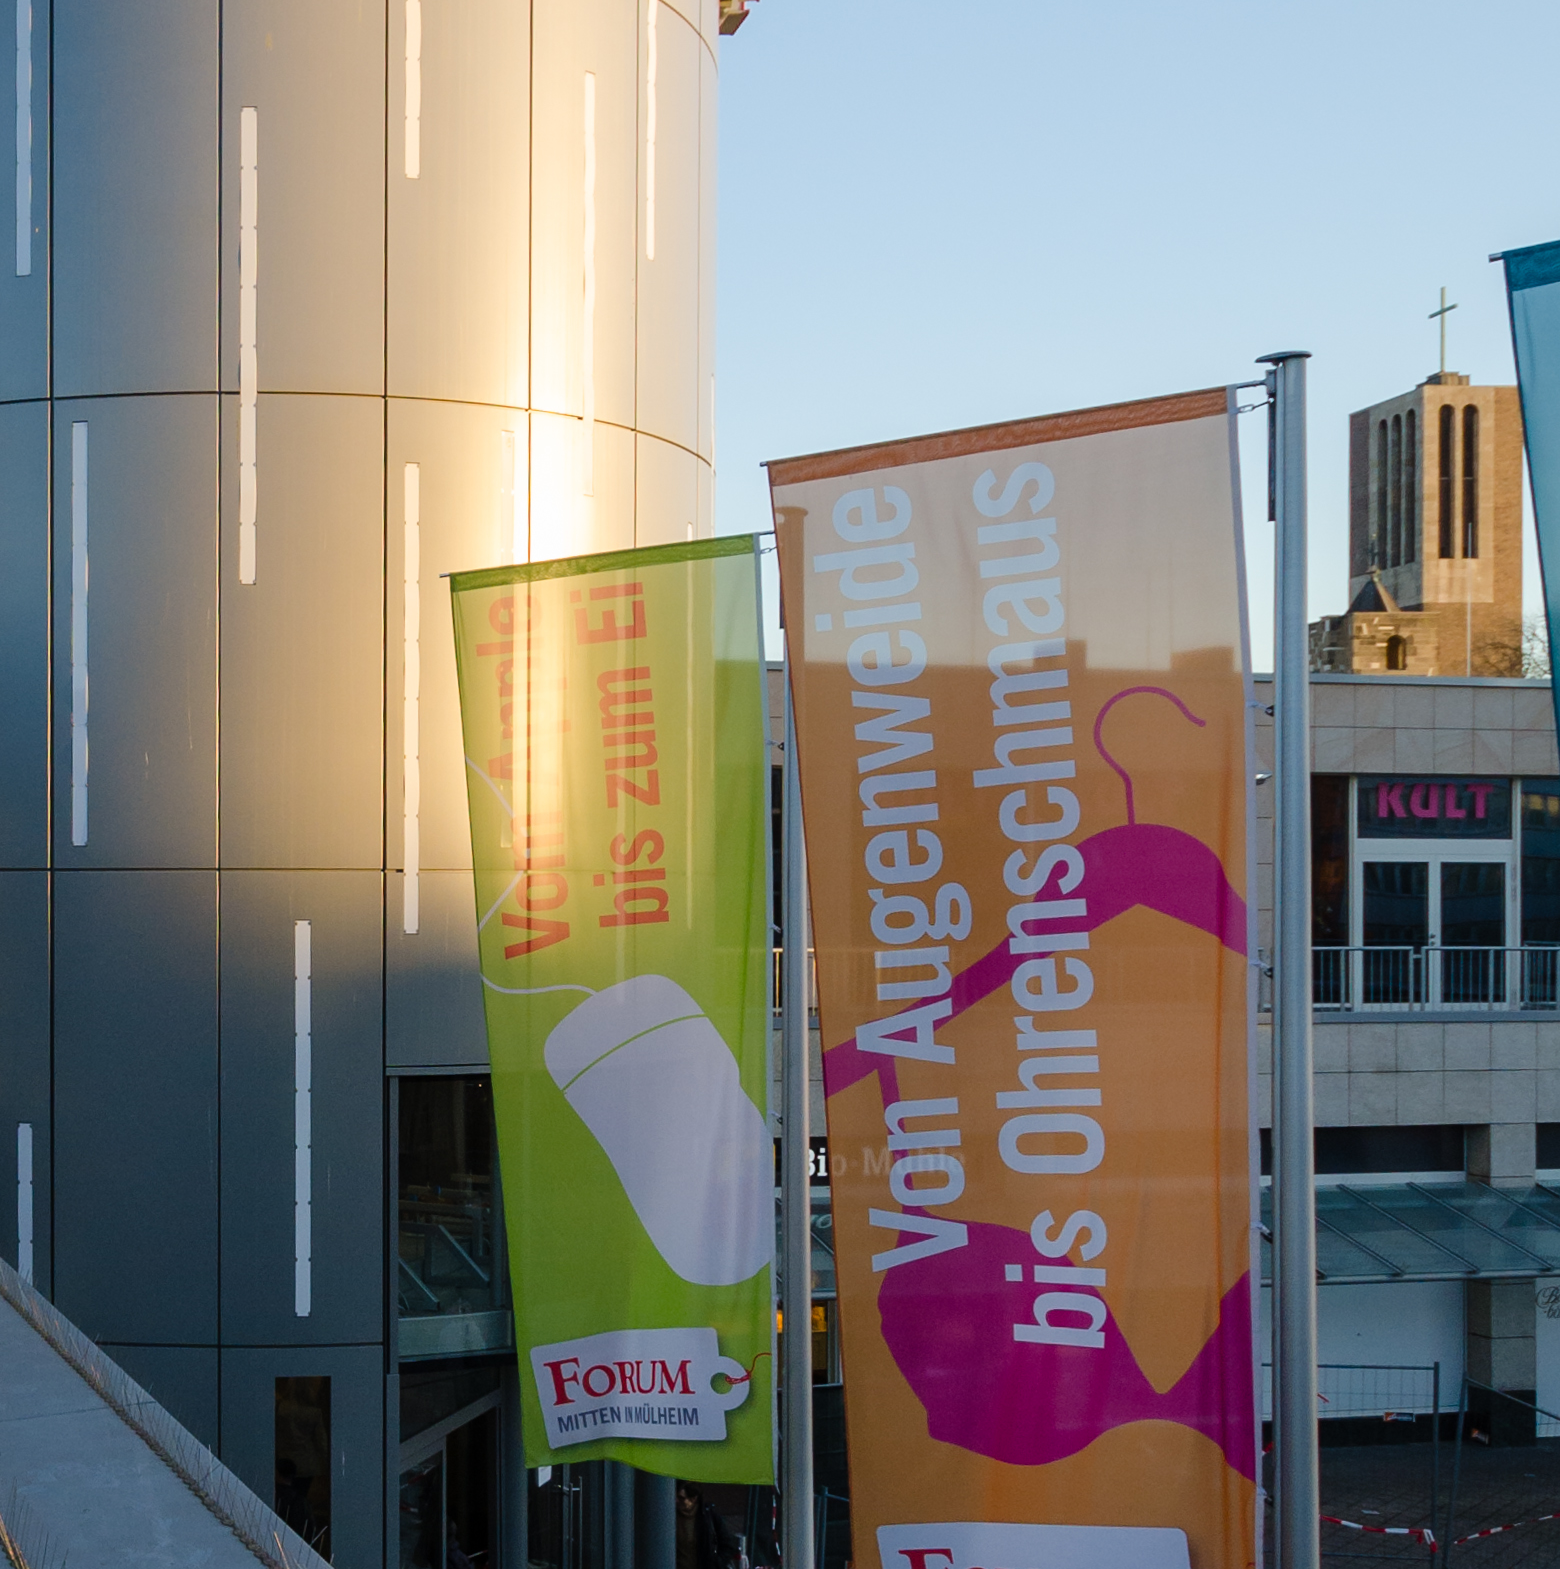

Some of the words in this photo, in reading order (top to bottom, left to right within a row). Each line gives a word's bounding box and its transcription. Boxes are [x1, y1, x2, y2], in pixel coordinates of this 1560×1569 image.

[569, 582, 648, 646] Ei
[596, 666, 660, 809] zum
[813, 485, 973, 1065] Augenweide
[1375, 782, 1495, 819] KULT
[501, 810, 571, 960] Vom
[593, 828, 670, 928] bis
[972, 461, 1106, 1175] Ohrenschmaus
[868, 1097, 969, 1273] Von
[1004, 1209, 1108, 1349] bis
[543, 1357, 696, 1406] FORUM
[557, 1406, 622, 1434] MITTEN
[624, 1406, 634, 1424] IN
[634, 1403, 700, 1426] MÜLHEIM
